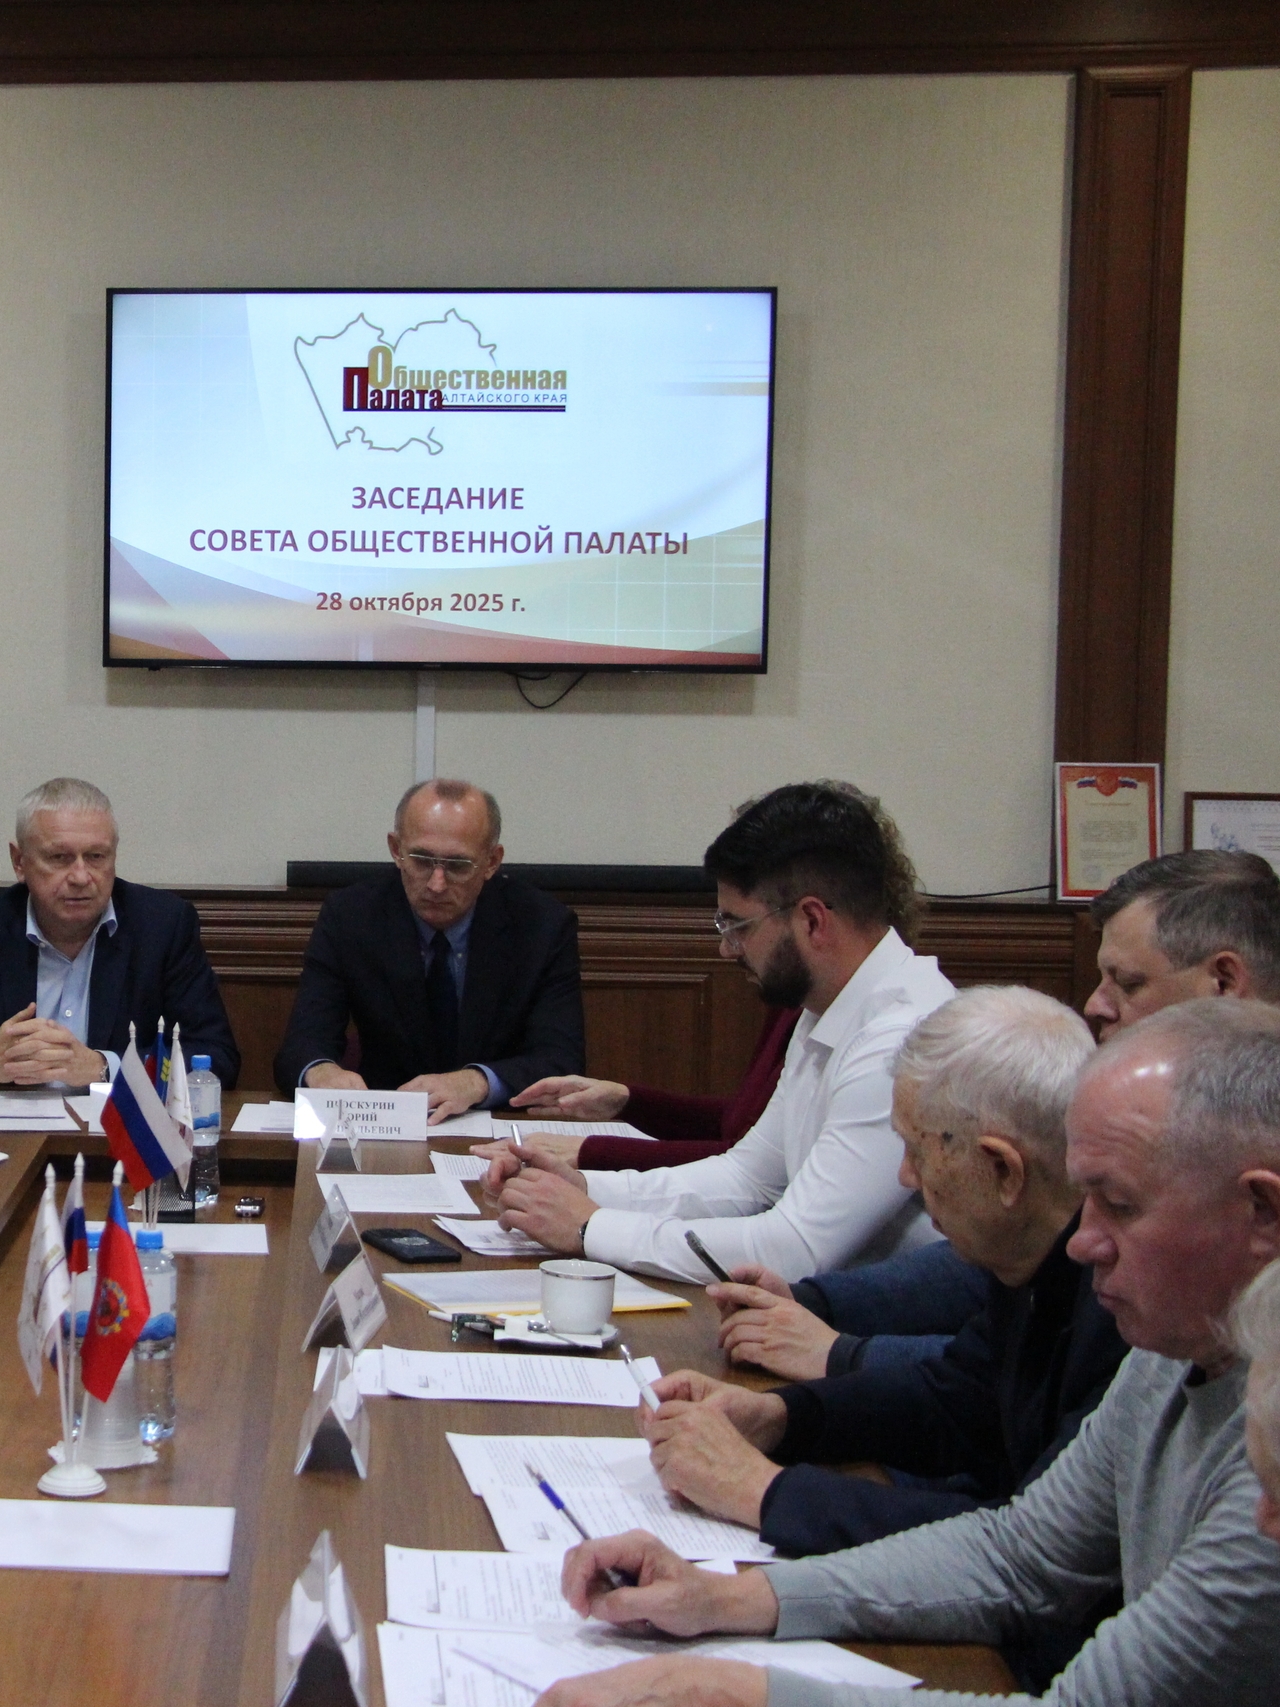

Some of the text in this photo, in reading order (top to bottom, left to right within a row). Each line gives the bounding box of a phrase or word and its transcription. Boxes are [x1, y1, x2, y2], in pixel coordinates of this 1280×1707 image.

[368, 345, 567, 390] Общественная
[343, 367, 443, 411] Палата
[442, 391, 568, 403] АЛТАЙСКОГО КРАЯ
[351, 486, 525, 515] ЗАСЕДАНИЕ
[189, 524, 688, 558] СОВЕТА ОБЩЕСТВЕННОЙ ПАЛАТЫ
[316, 591, 526, 616] 28 октября 2025 г.
[326, 1100, 395, 1110] ПОСКУРИН
